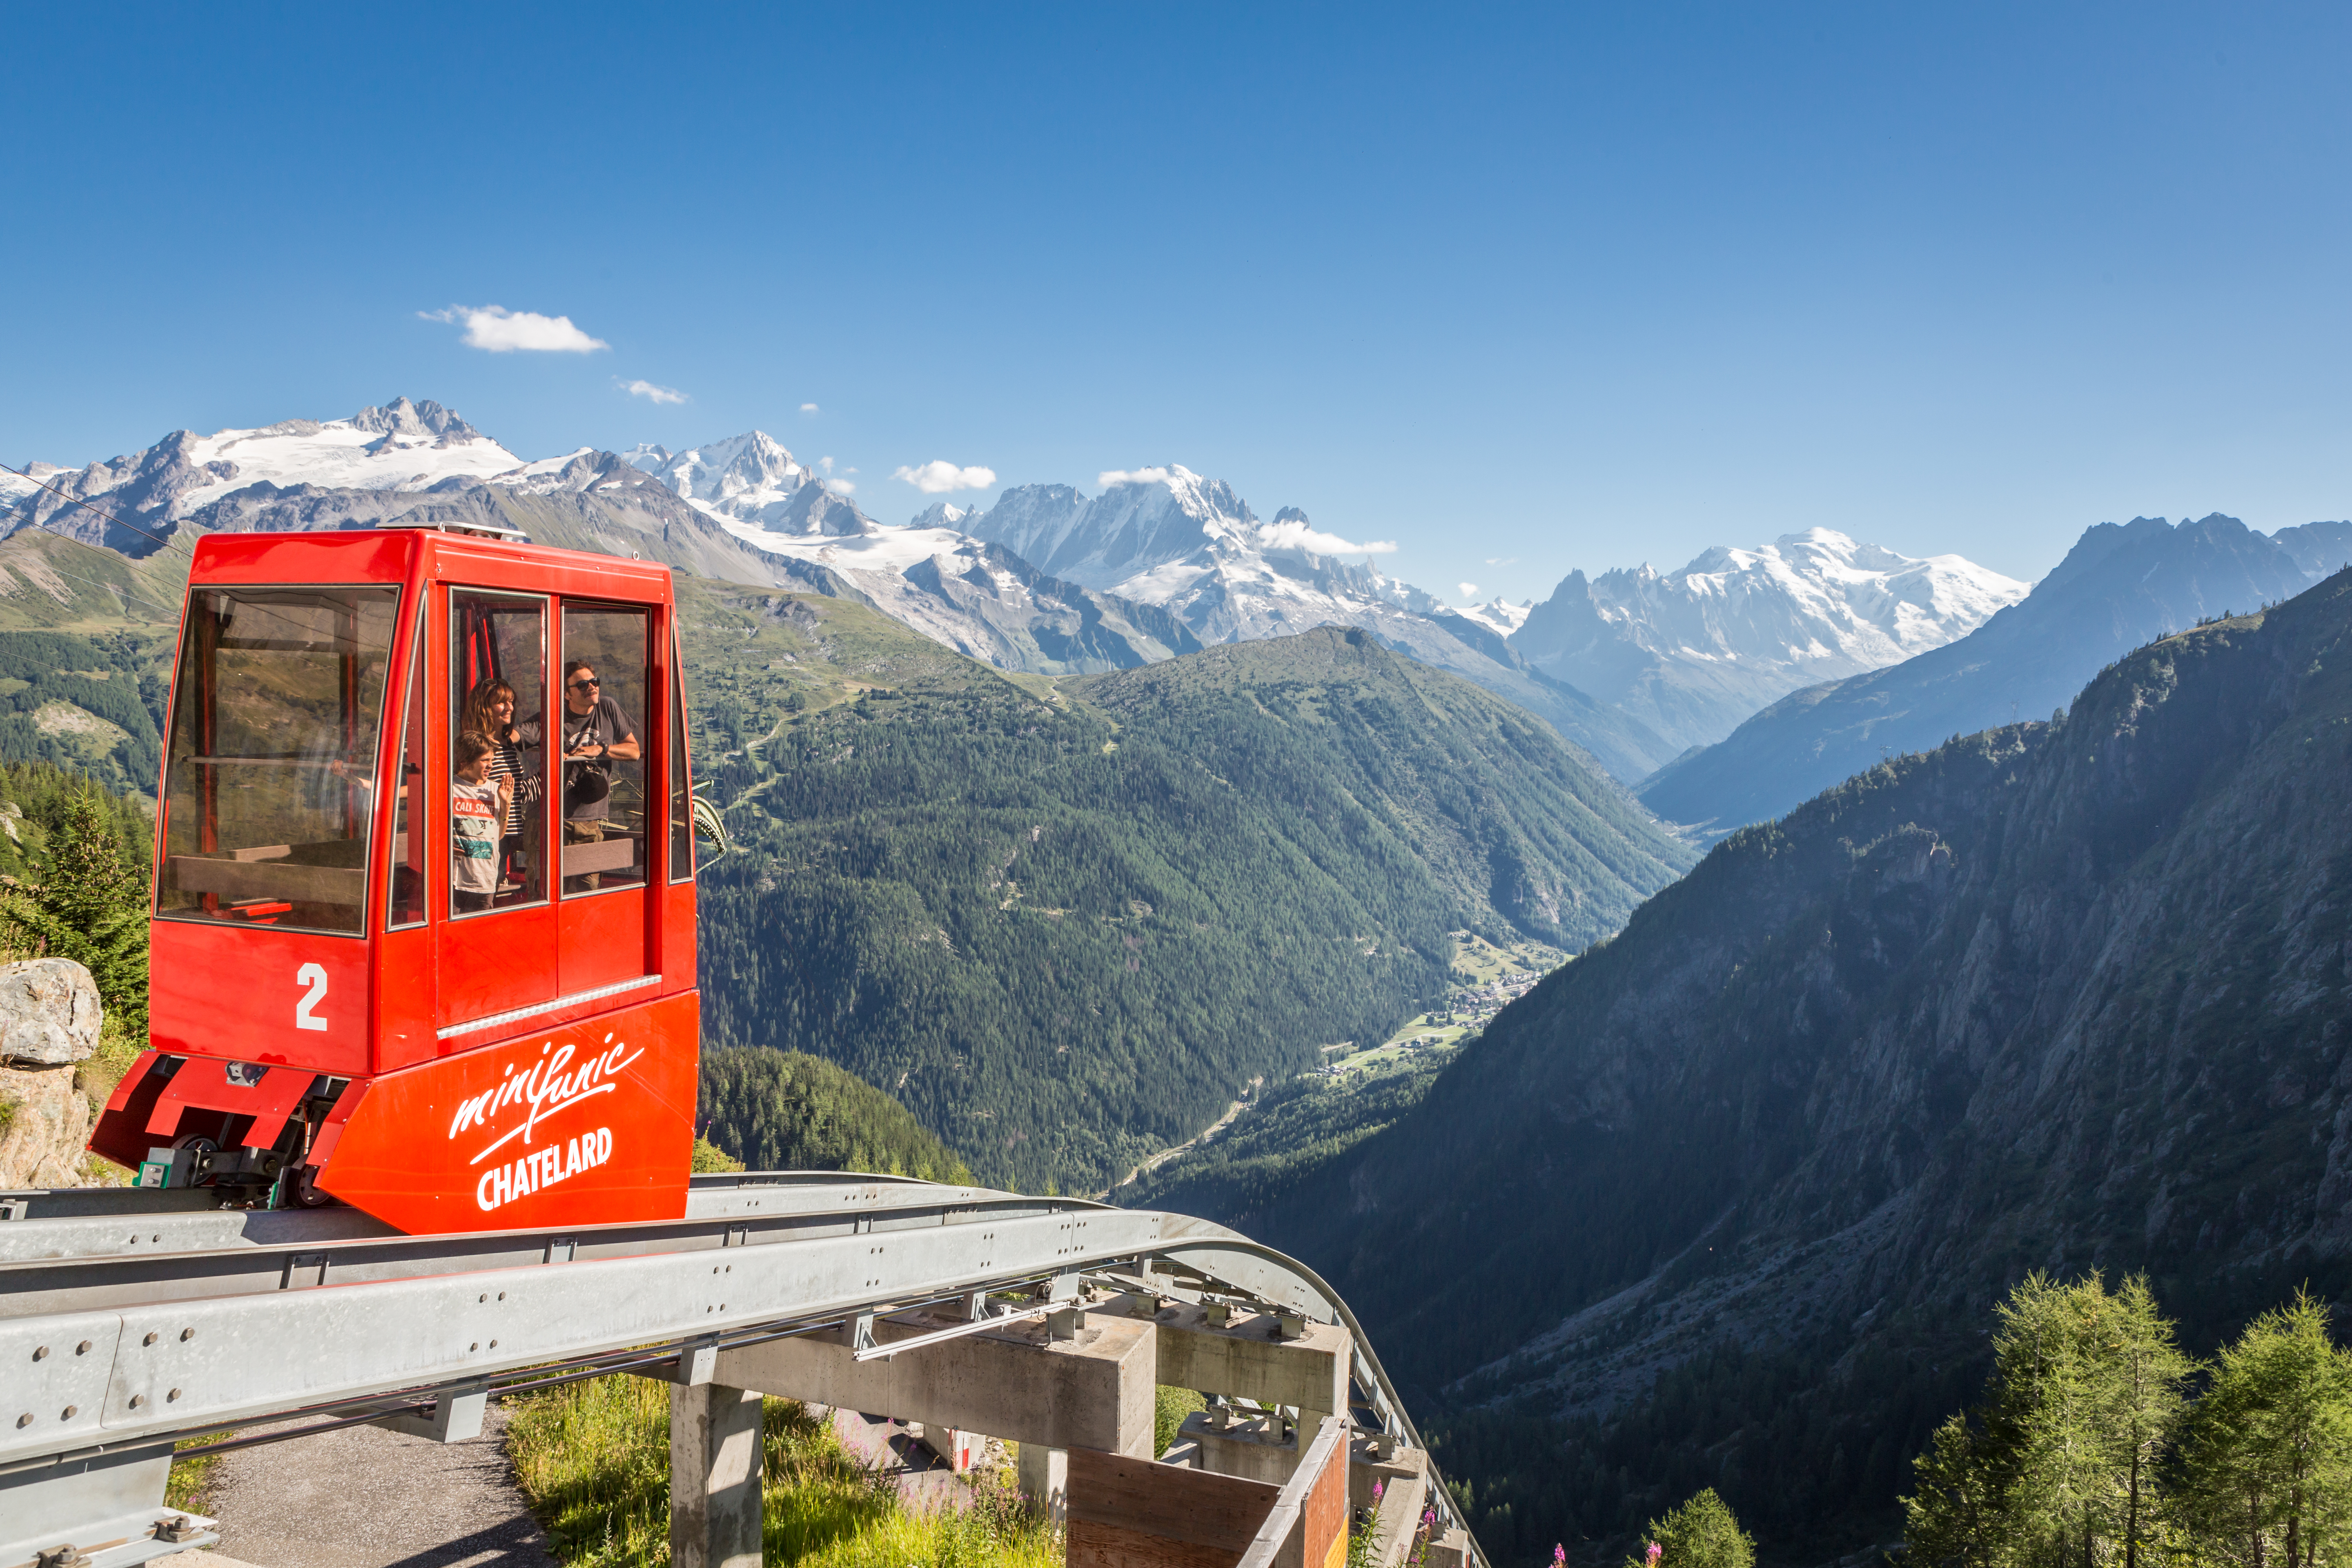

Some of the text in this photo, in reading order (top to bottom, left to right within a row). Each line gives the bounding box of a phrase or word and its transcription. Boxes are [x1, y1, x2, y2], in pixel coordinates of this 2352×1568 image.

[455, 802, 494, 815] CALI SKATE
[296, 962, 327, 1031] 2
[449, 1032, 645, 1144] minifunic
[477, 1127, 612, 1212] CHATELARD
